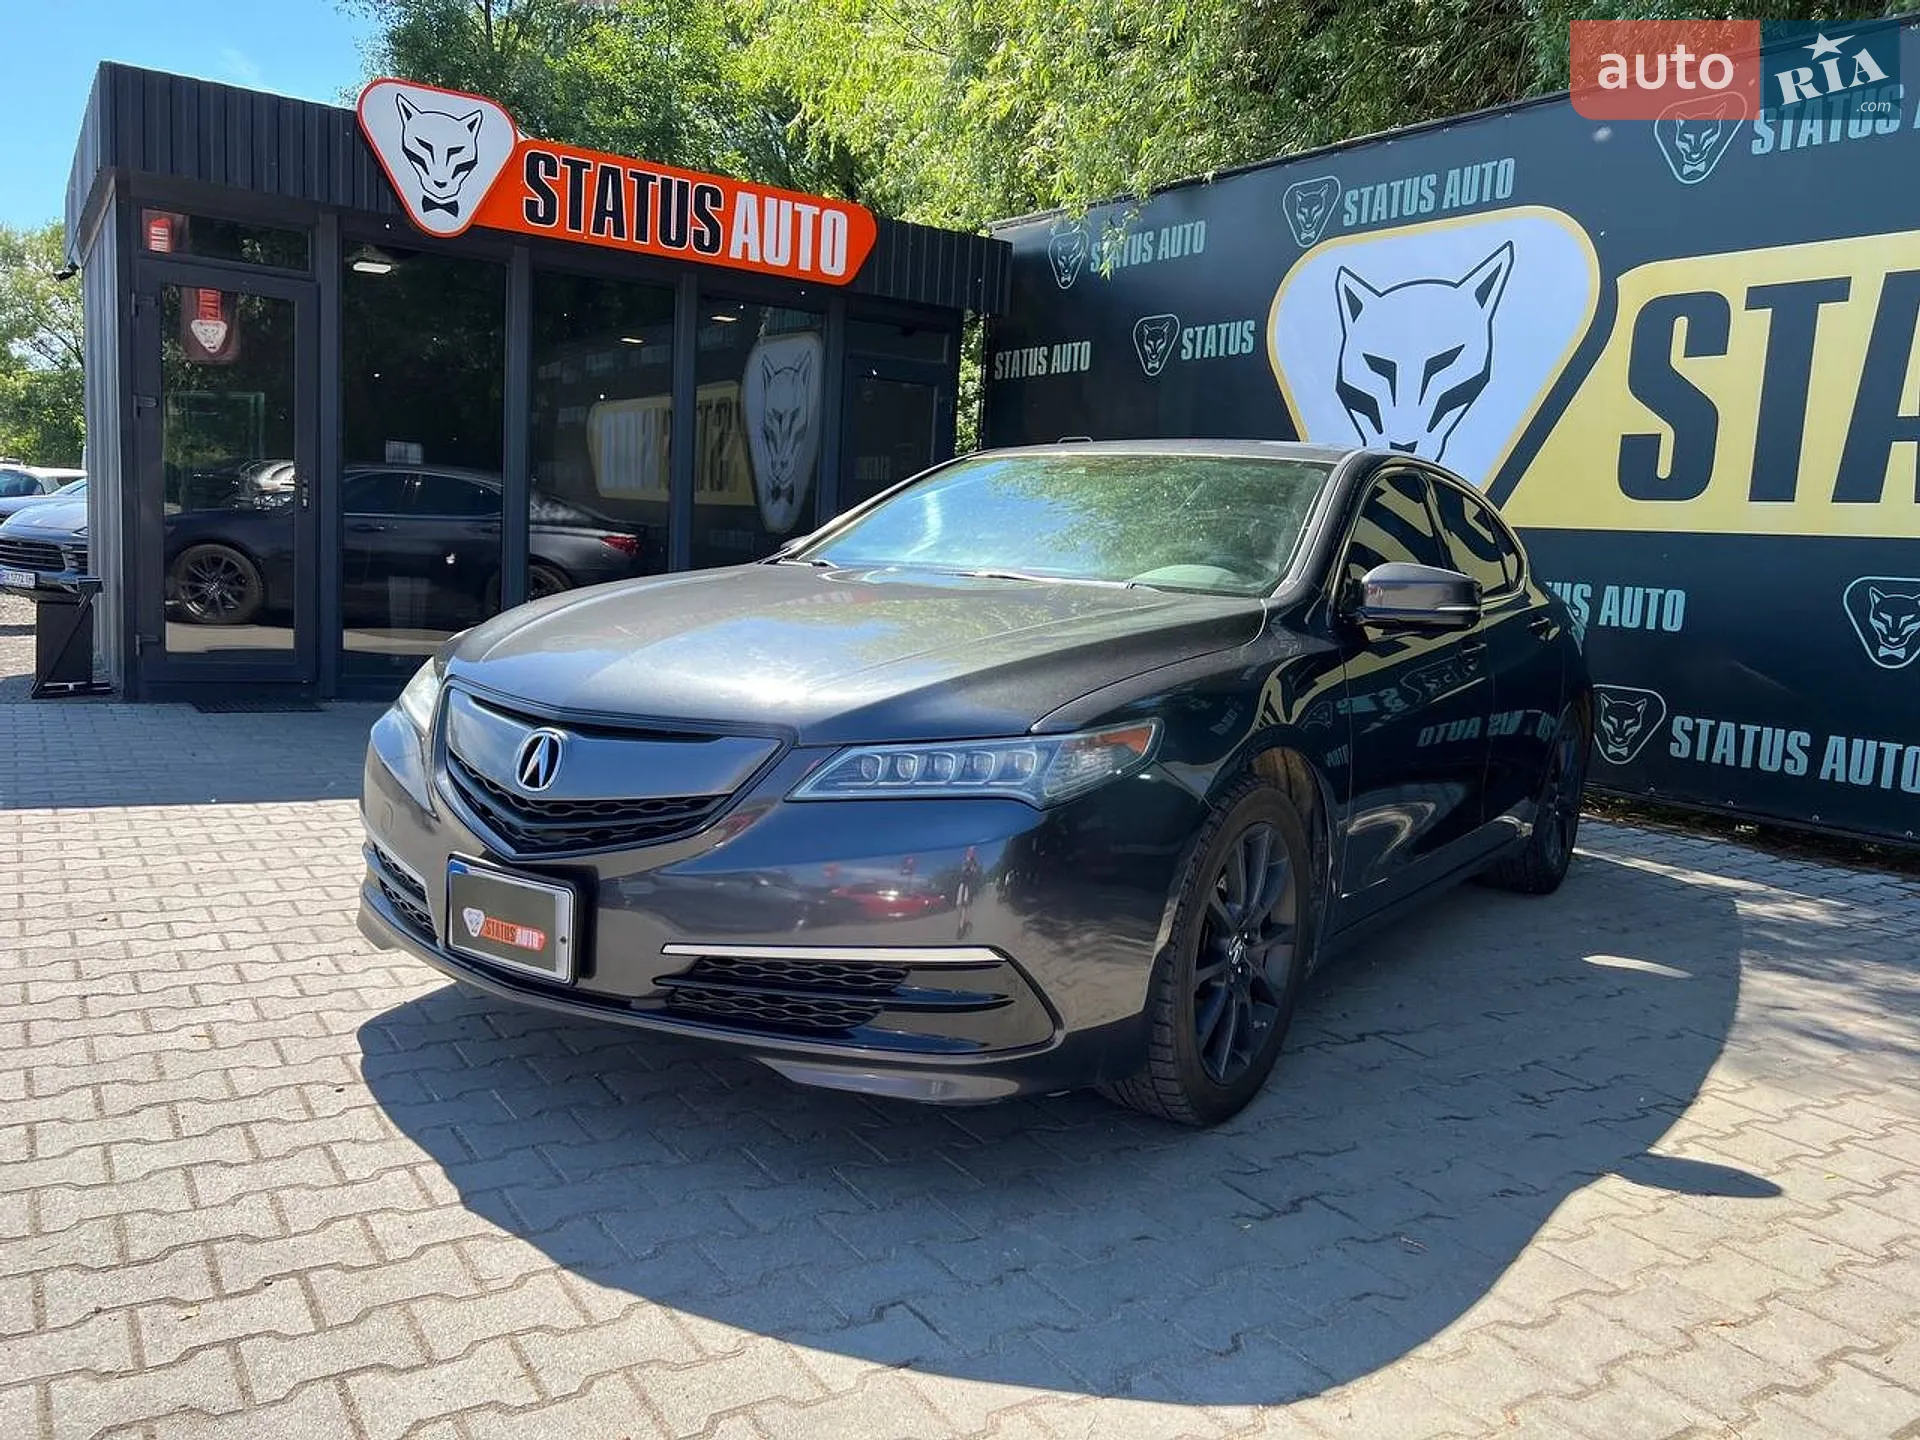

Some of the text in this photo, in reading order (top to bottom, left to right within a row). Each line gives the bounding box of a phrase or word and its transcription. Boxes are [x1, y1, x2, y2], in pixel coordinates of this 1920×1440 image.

[523, 150, 848, 277] STATUS AUTO
[1343, 157, 1515, 227] STATUS AUTO
[1090, 220, 1206, 273] SATUS AUTO
[994, 341, 1091, 380] STATUS AUTO
[1181, 320, 1255, 360] STATUS
[1598, 585, 1686, 632] AUTO
[1669, 715, 1920, 795] STATUS AUTO
[486, 919, 516, 942] STATUS
